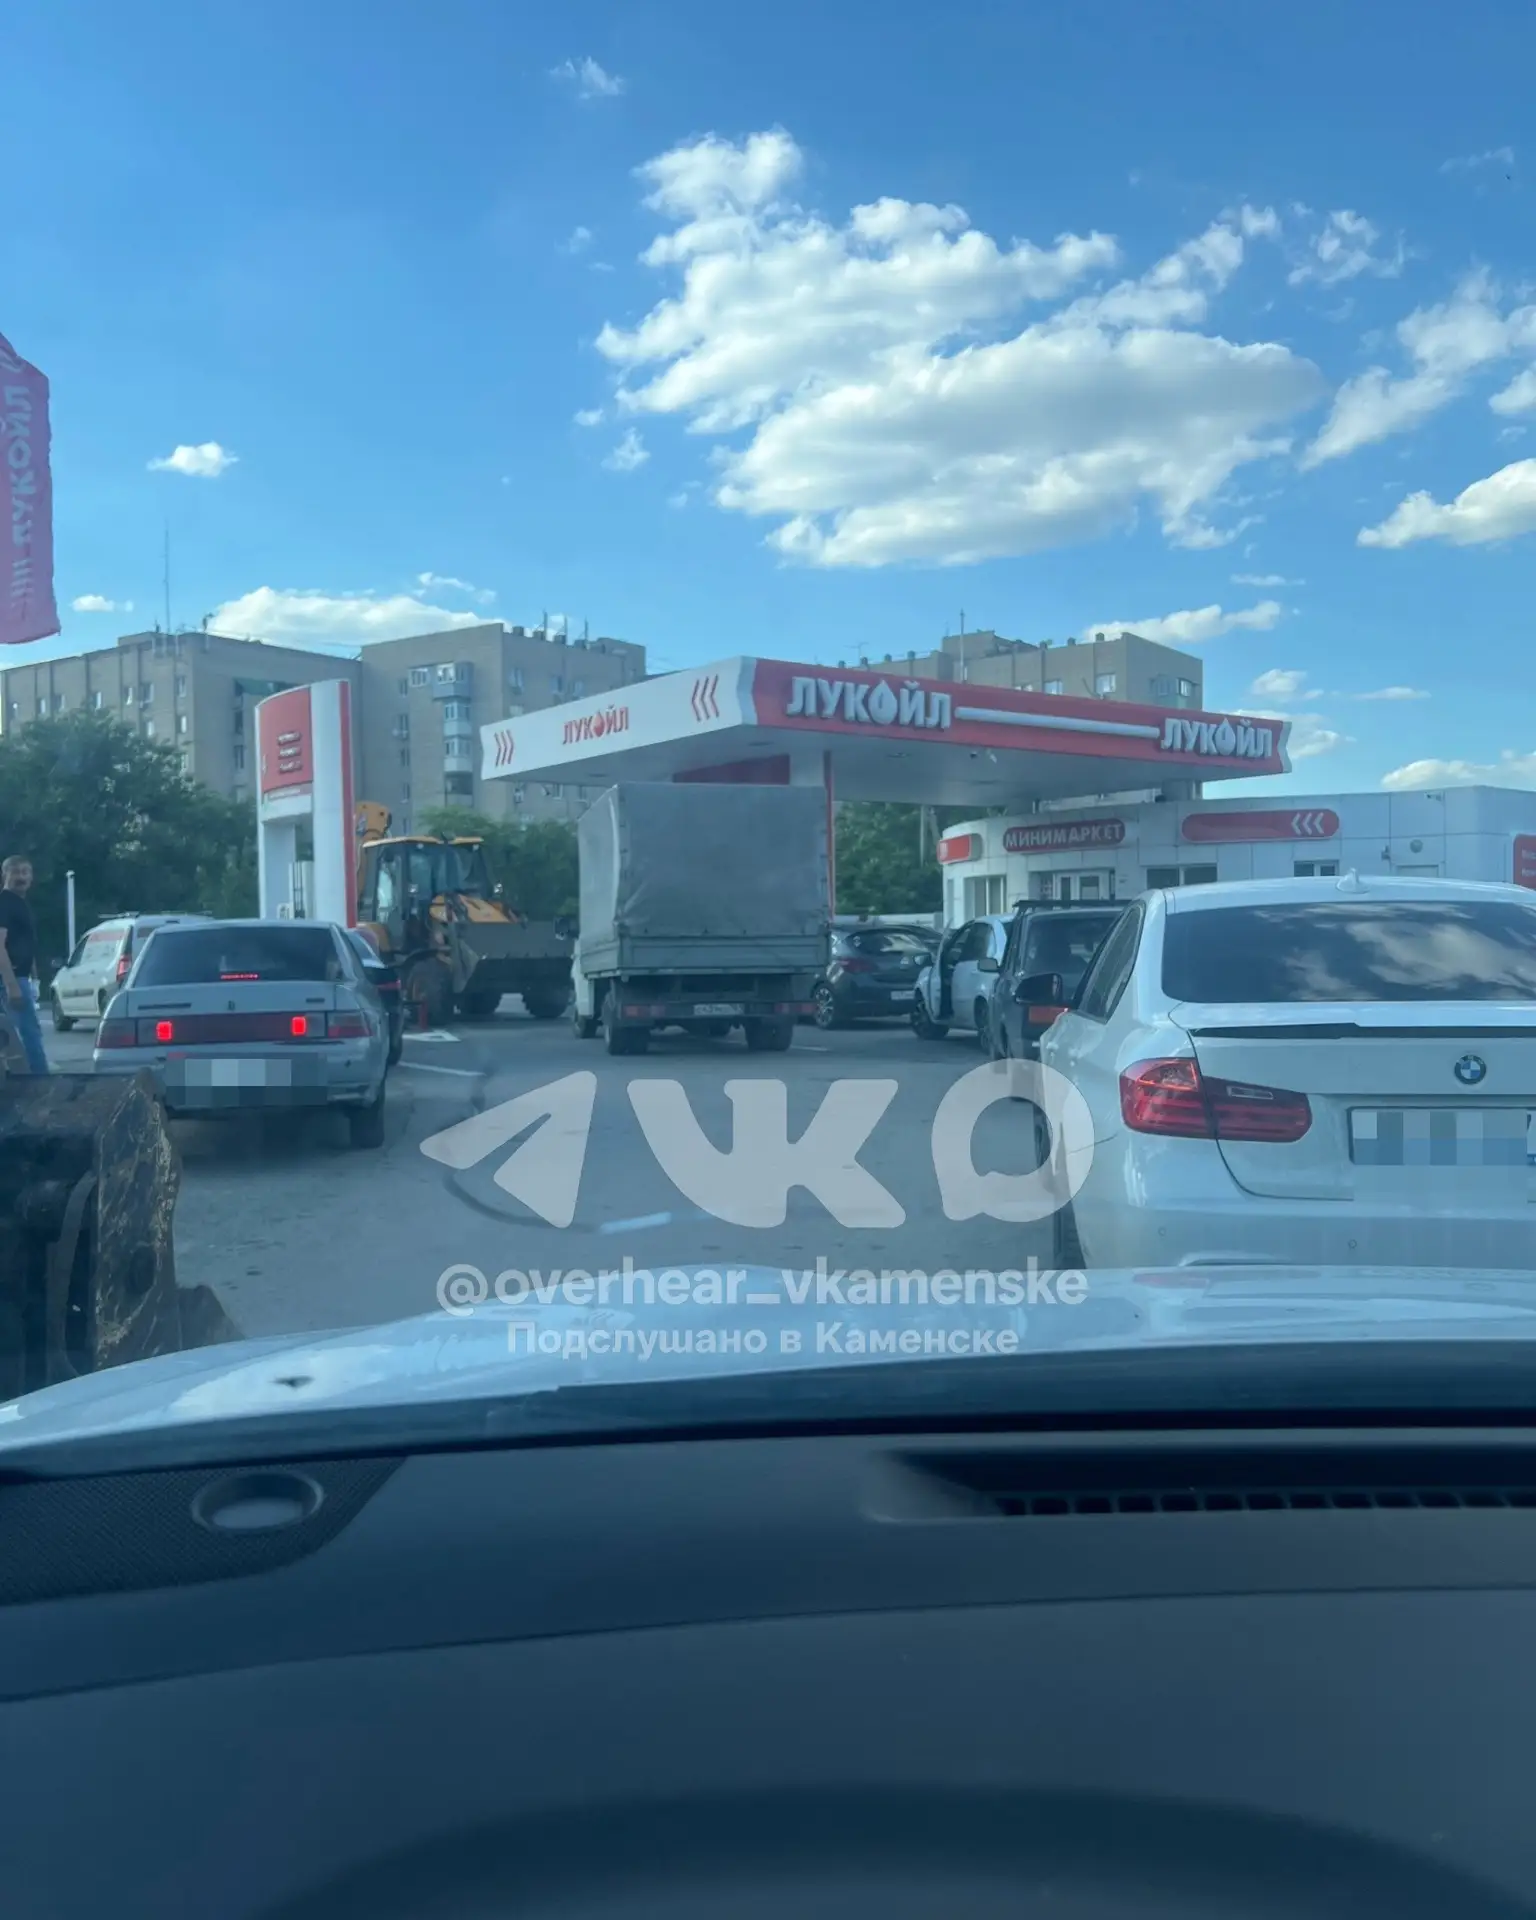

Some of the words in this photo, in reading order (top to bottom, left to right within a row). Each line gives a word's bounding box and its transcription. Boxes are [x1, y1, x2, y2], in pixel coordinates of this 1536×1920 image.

[786, 676, 952, 730] ЛУКОЙЛ
[562, 704, 629, 745] ЛУКОЙЛ
[1160, 717, 1273, 758] ЛУКОЙЛ
[1005, 823, 1122, 848] МИНИМАРКЕТ
